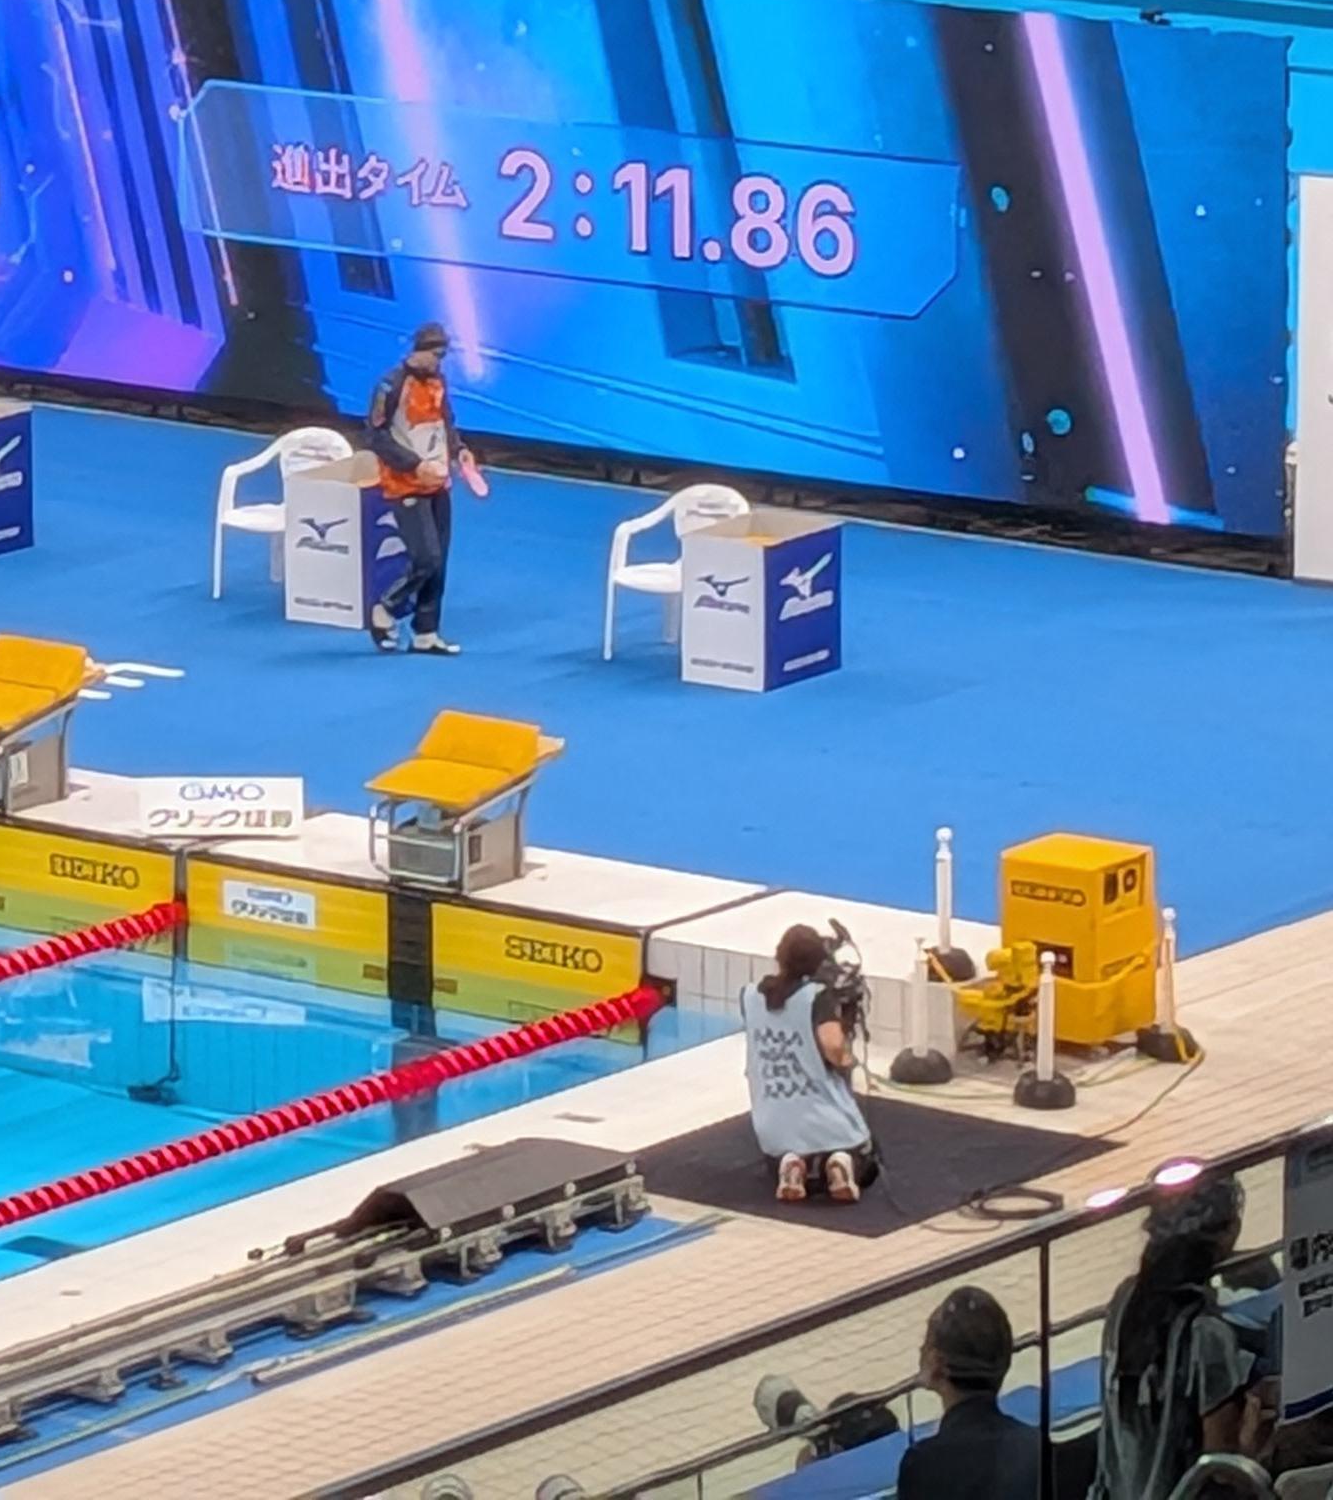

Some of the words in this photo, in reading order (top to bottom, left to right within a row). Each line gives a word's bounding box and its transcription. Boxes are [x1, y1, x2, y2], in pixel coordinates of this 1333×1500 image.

[499, 149, 857, 277] 2:11.86
[49, 852, 140, 890] SEIKO
[504, 934, 603, 974] SEIKO
